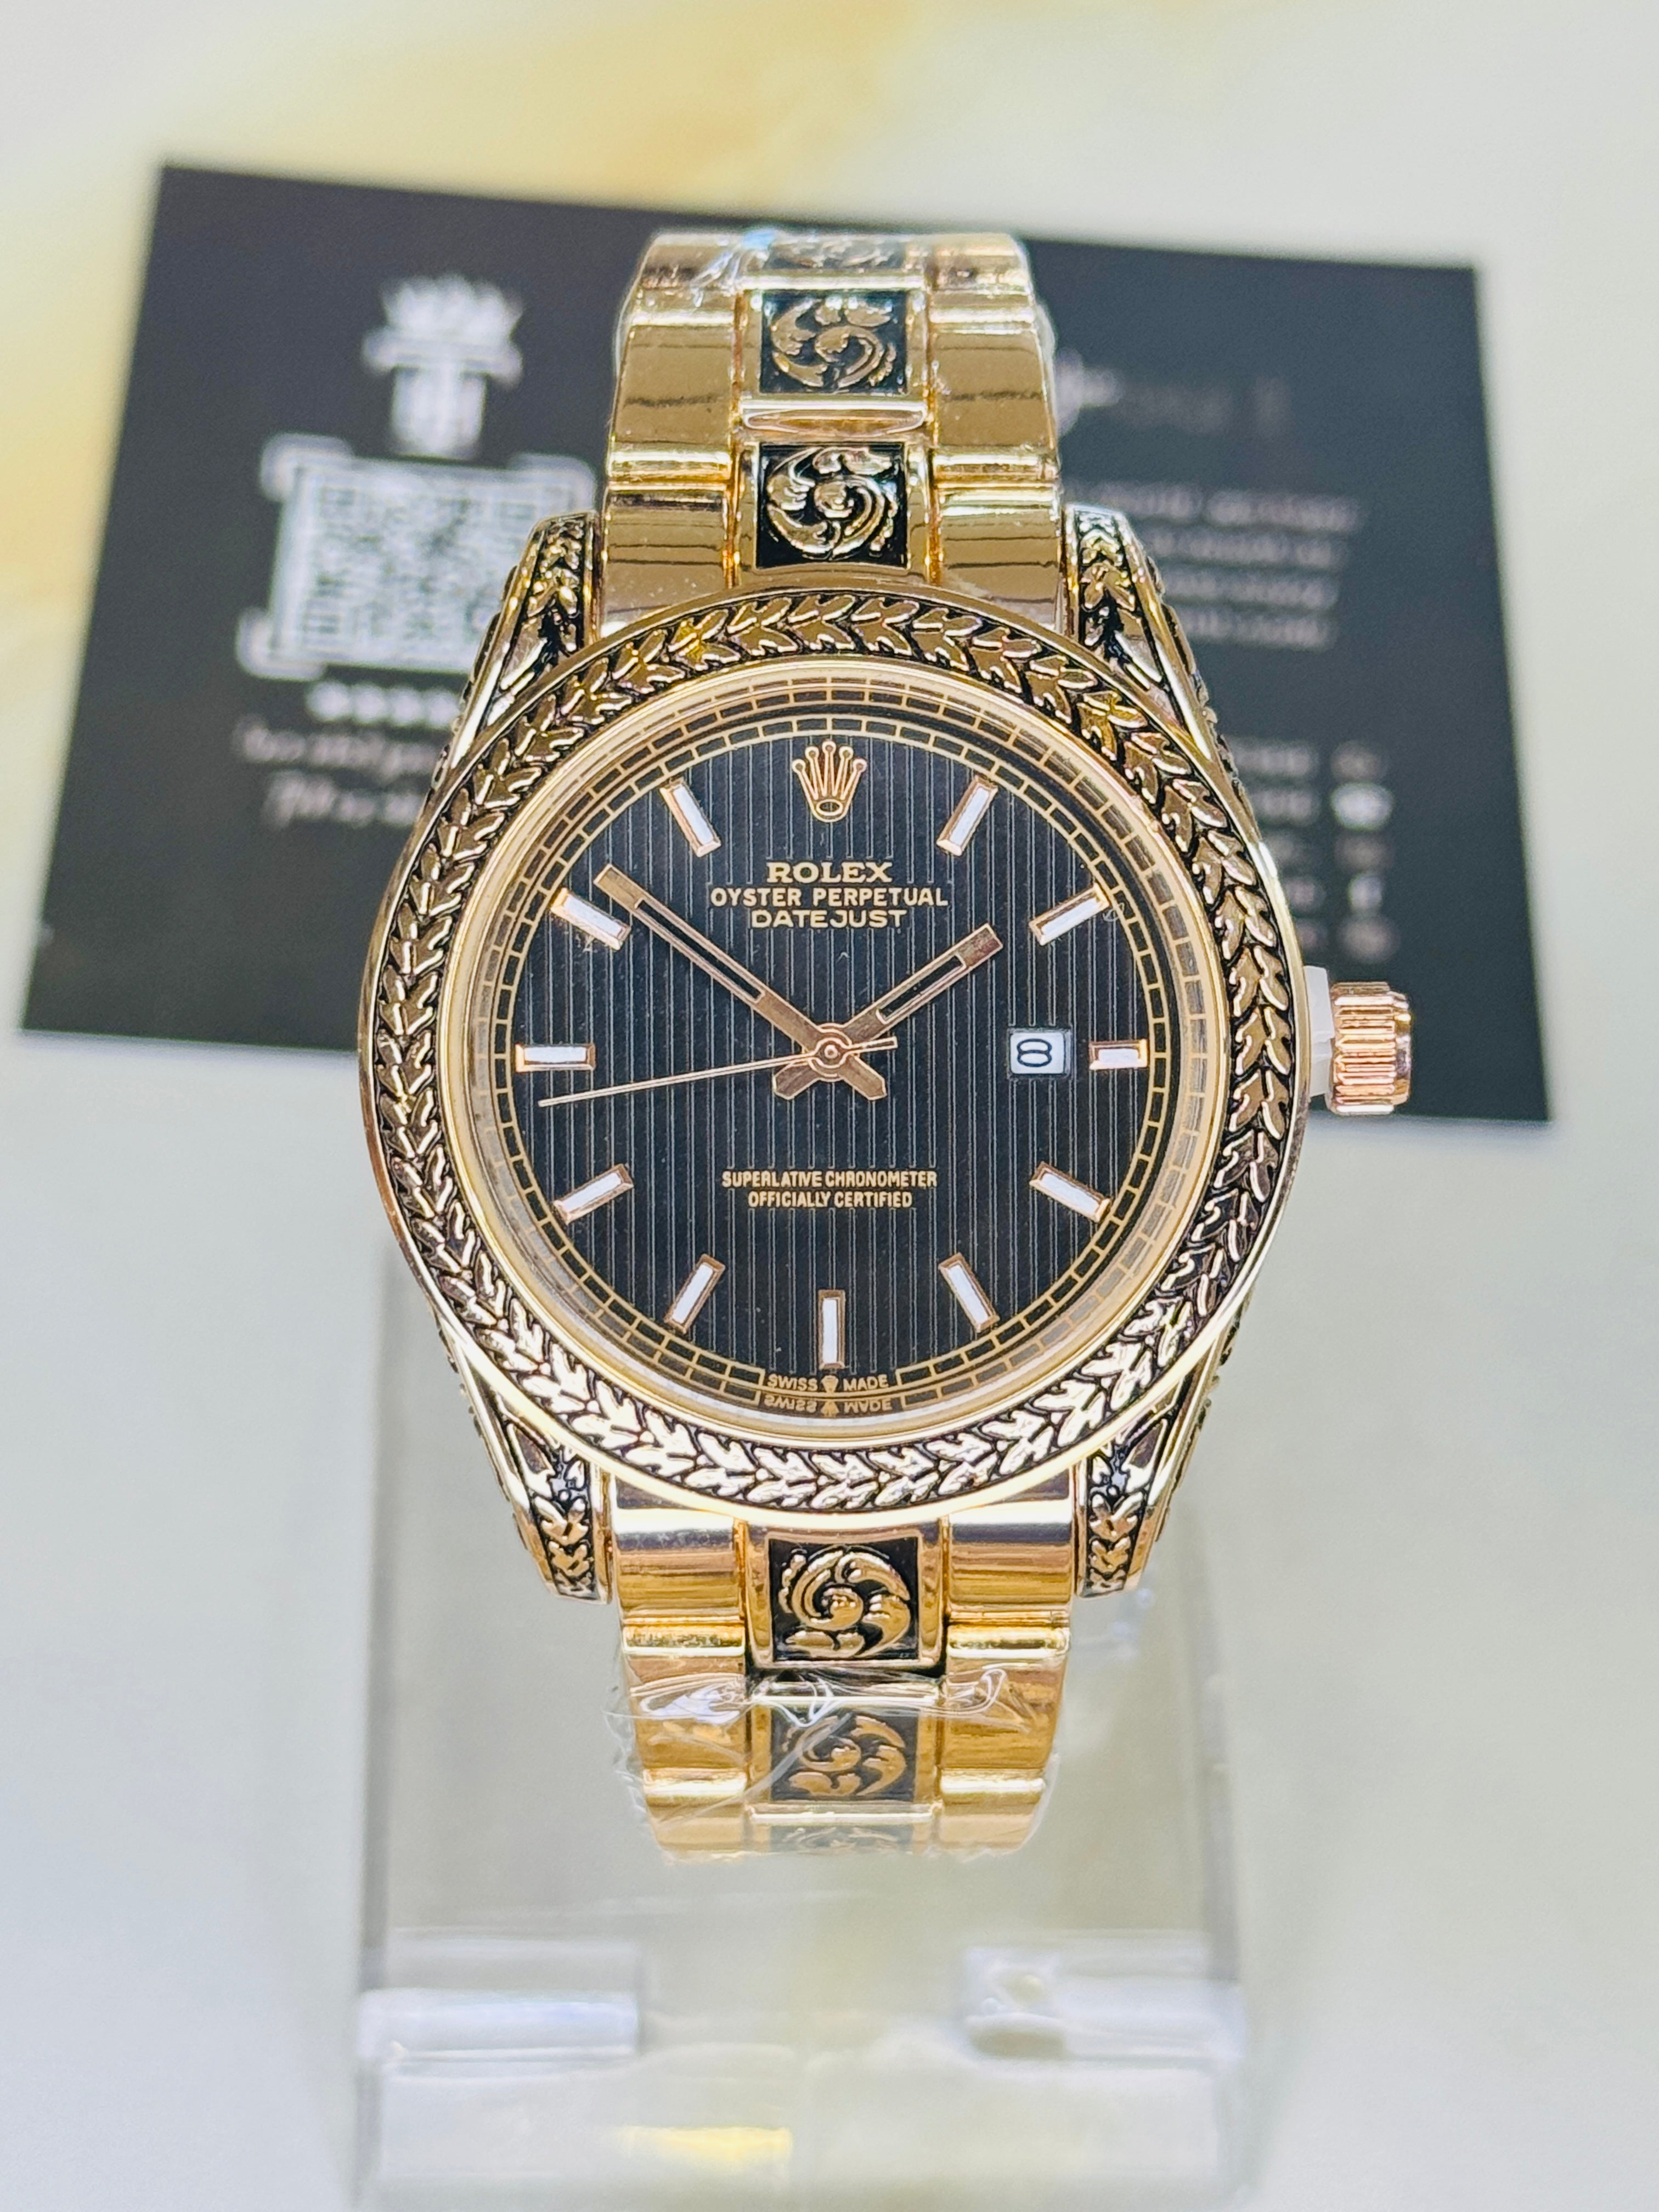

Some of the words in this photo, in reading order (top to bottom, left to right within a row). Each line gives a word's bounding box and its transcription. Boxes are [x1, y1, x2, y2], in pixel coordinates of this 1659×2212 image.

[766, 862, 893, 883] ROLEX
[711, 888, 801, 906] OYSTER
[812, 888, 948, 906] PERPETUAL
[752, 910, 907, 928] DATEJUST
[1017, 1038, 1052, 1067] 8
[722, 1171, 822, 1188] SUPERLATIVE
[825, 1171, 937, 1188] CHRONOMETER
[748, 1191, 831, 1207] OFFICIALLY
[834, 1191, 912, 1207] CERTIFIED
[768, 1373, 818, 1391] SWISS
[843, 1374, 889, 1391] MADE
